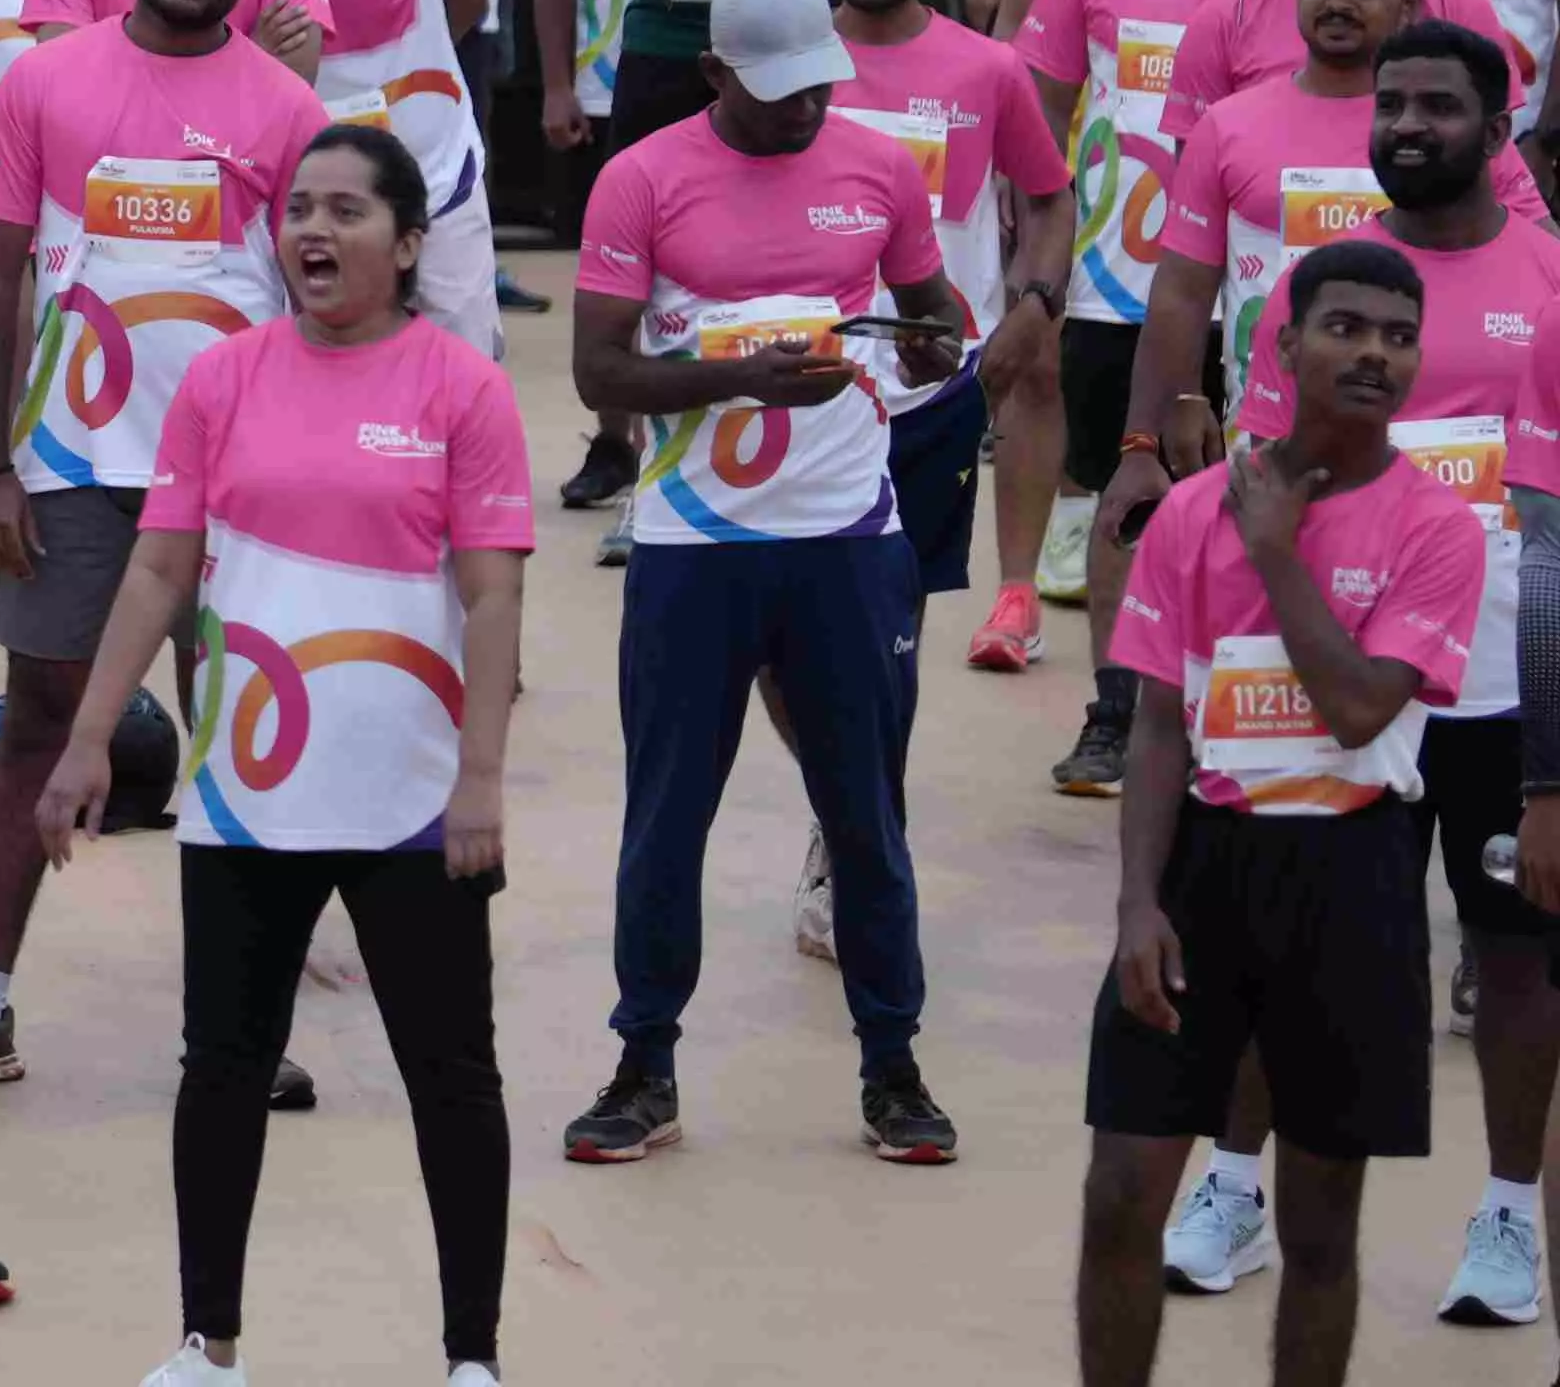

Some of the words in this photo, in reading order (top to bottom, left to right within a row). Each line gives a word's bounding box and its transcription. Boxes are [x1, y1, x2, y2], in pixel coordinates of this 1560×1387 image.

[114, 195, 192, 225] 10336
[1484, 311, 1525, 327] PINK
[1484, 325, 1535, 341] POWER
[1232, 683, 1312, 716] 11218
